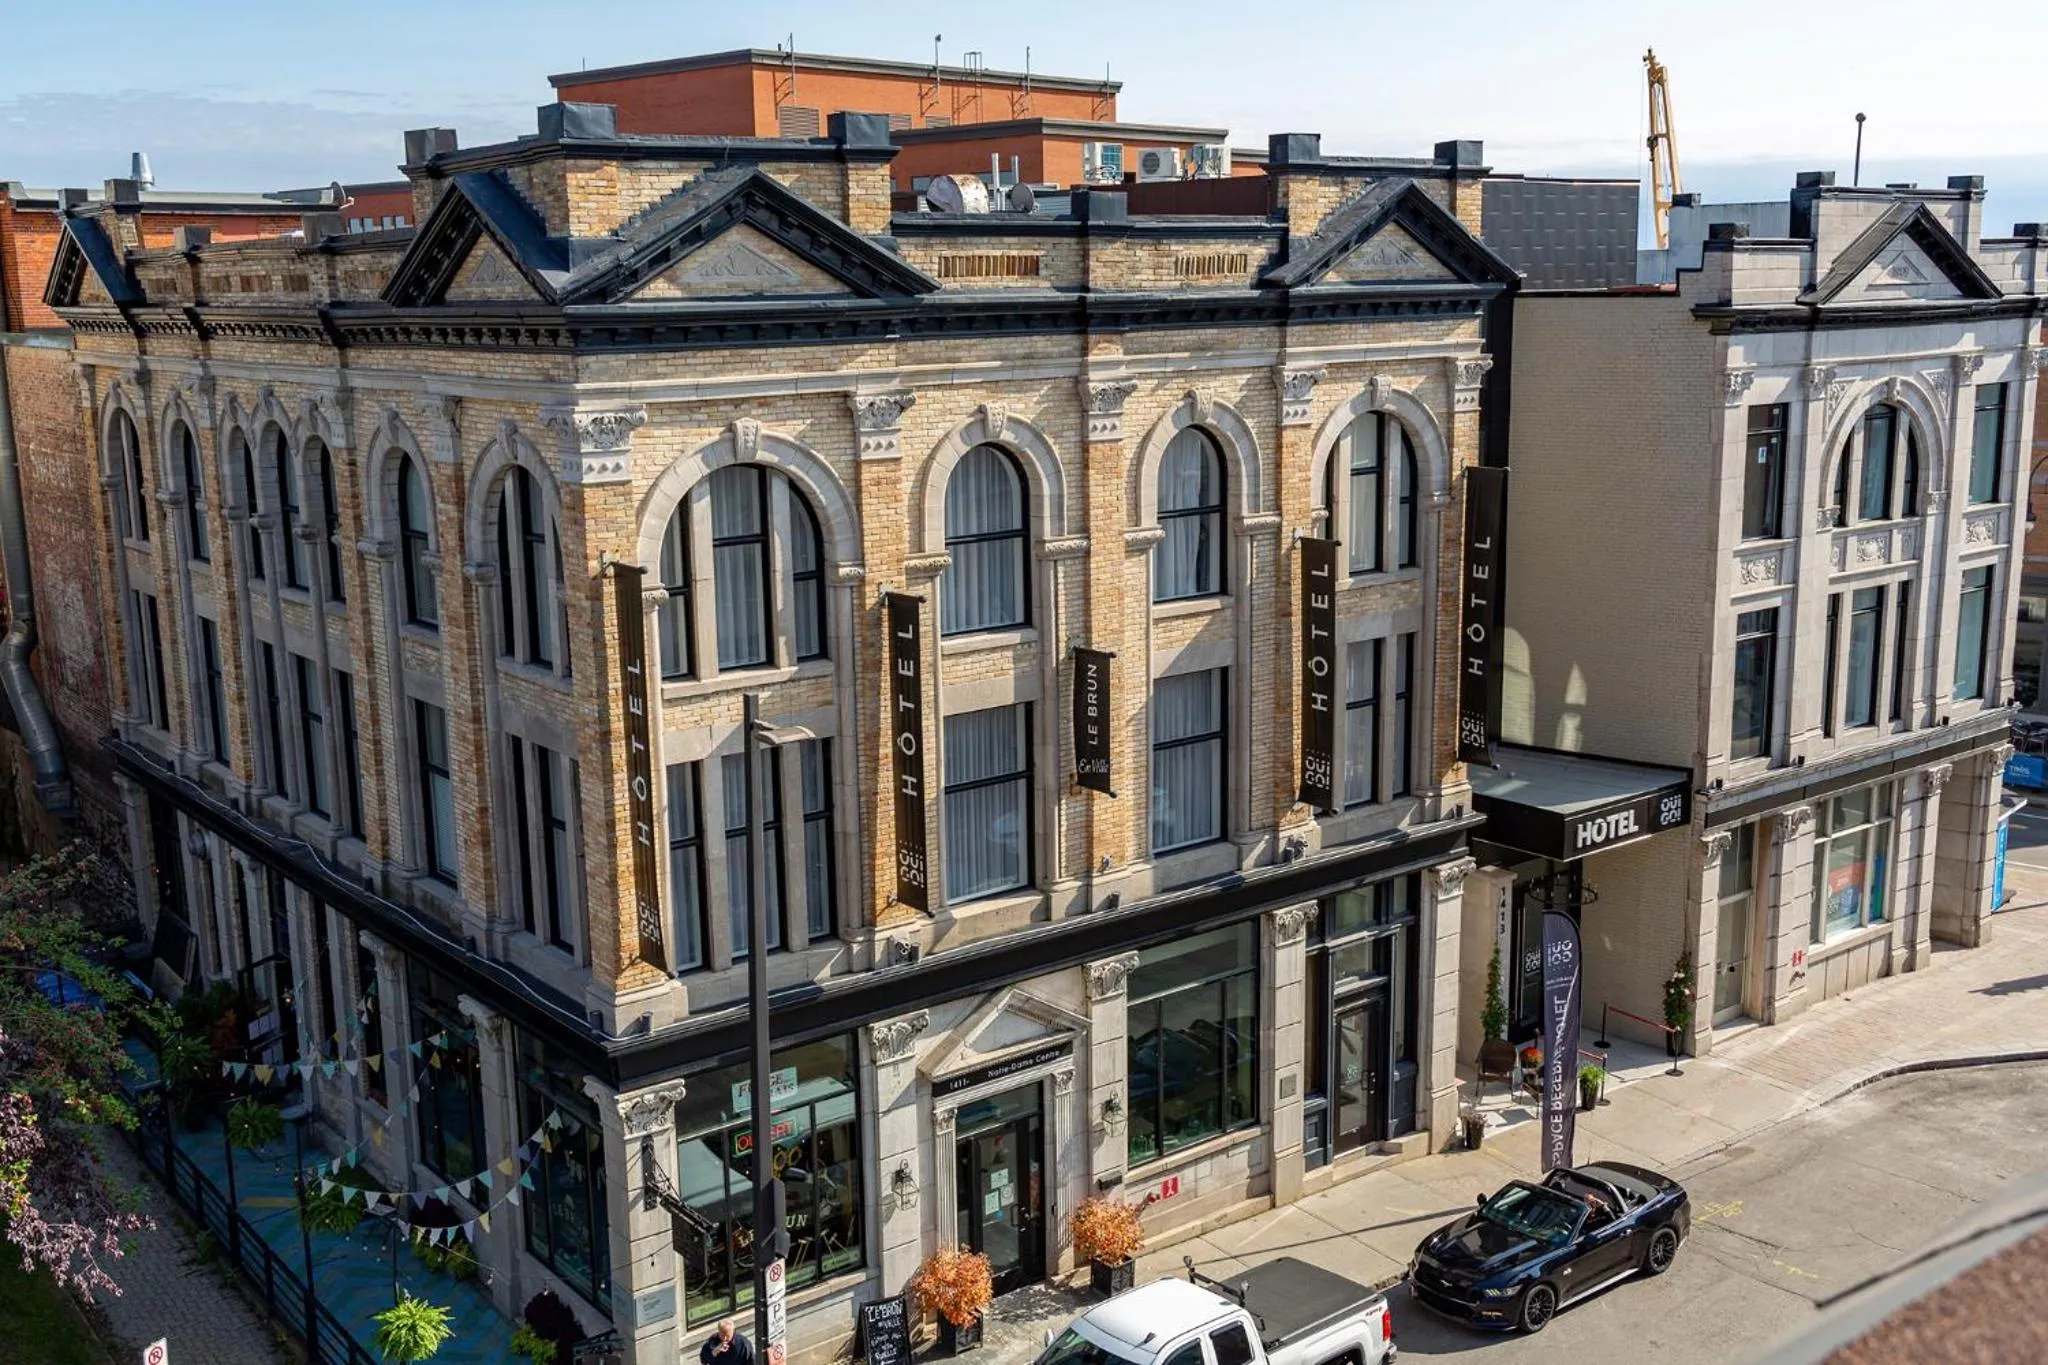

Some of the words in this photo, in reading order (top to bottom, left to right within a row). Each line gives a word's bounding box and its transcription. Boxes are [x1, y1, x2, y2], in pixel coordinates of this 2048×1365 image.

[1309, 563, 1329, 711] HÔTEL
[1467, 536, 1491, 675] HÔTEL
[628, 658, 650, 846] HÔTEL
[897, 623, 917, 797] HÔTEL
[1088, 664, 1099, 717] BRUN
[1088, 724, 1098, 745] LE
